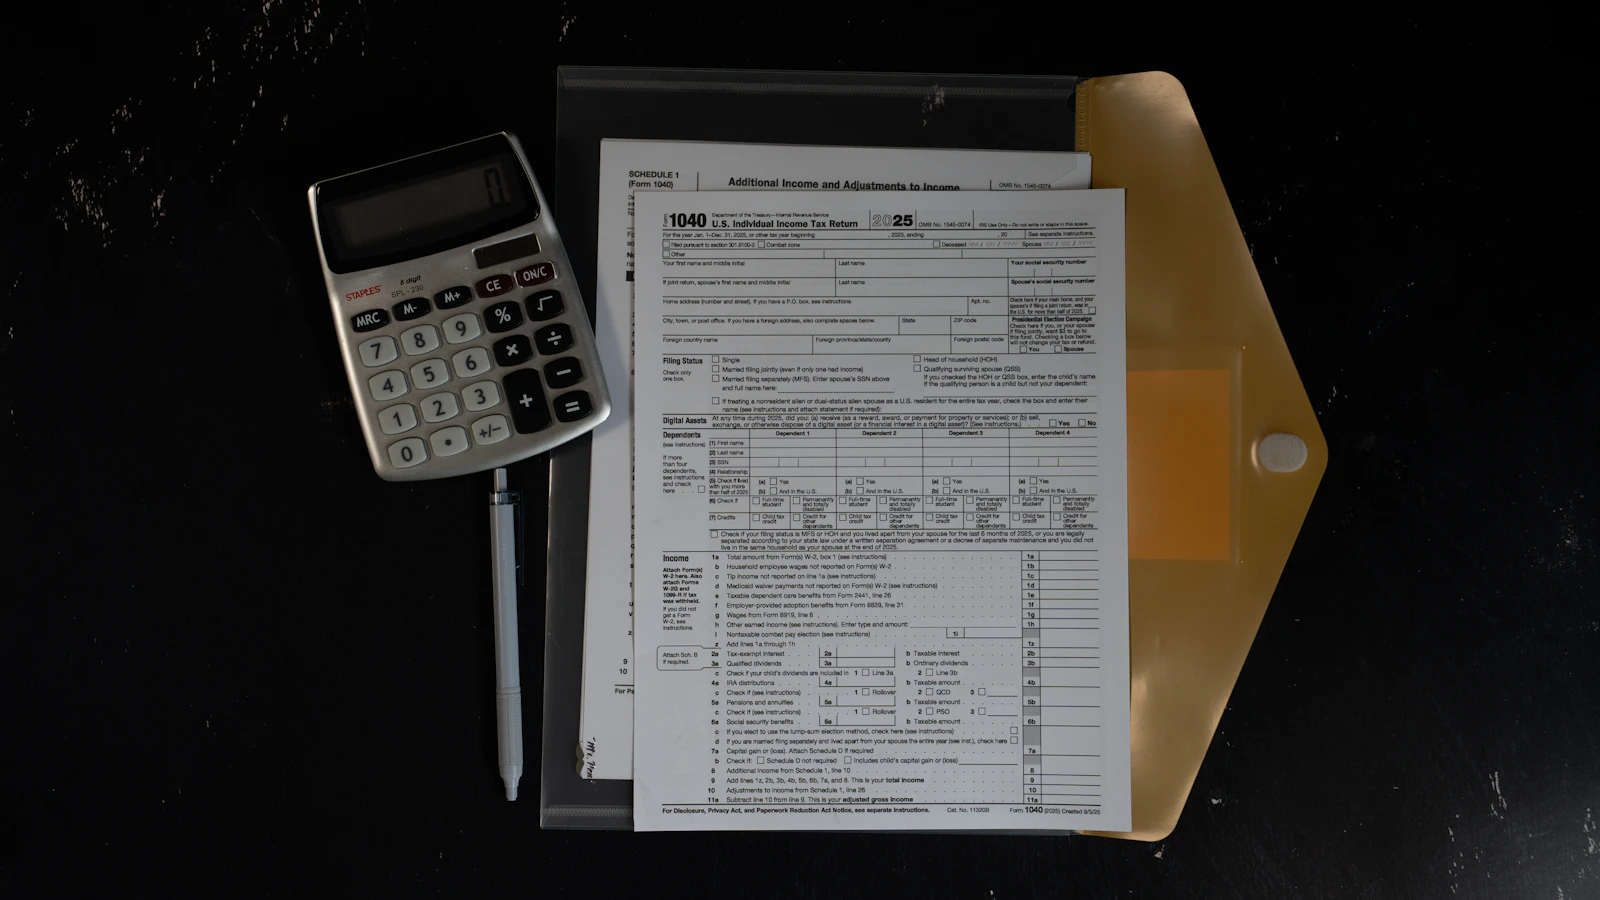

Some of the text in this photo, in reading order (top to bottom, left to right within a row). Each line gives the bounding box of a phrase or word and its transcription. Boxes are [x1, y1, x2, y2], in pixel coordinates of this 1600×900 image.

[628, 170, 673, 179] SCHEDULE
[628, 180, 674, 190] (Form 1040)
[728, 177, 779, 188] Additional
[782, 178, 819, 189] Income
[822, 179, 840, 188] and
[843, 180, 907, 191] Adjustments
[669, 213, 707, 228] 1040
[712, 220, 730, 228] U.S.
[776, 220, 808, 228] Income
[810, 220, 827, 228] Tax
[829, 219, 858, 228] Return
[872, 214, 914, 227] 2025
[406, 275, 421, 284] digit
[522, 266, 548, 282] ON/C
[392, 290, 405, 298] SPL
[411, 285, 423, 293] 230
[486, 279, 501, 292] CE
[346, 285, 381, 301] STAPLES
[444, 290, 461, 303] M+
[404, 303, 417, 315] M-
[495, 308, 510, 323] %
[357, 312, 380, 327] MRC
[456, 321, 467, 336] 9
[415, 333, 425, 348] 8
[371, 343, 381, 359] 7
[466, 355, 477, 370] 6
[663, 357, 681, 365] Filing
[722, 356, 741, 364] Single
[424, 367, 435, 382] 5
[383, 378, 394, 393] 4
[475, 389, 486, 404] 3
[432, 401, 445, 416] 2
[393, 412, 402, 427] 1
[663, 417, 684, 426] Digital
[663, 431, 701, 440] Dependents
[401, 447, 412, 462] 0
[1025, 805, 1044, 814] 1040
